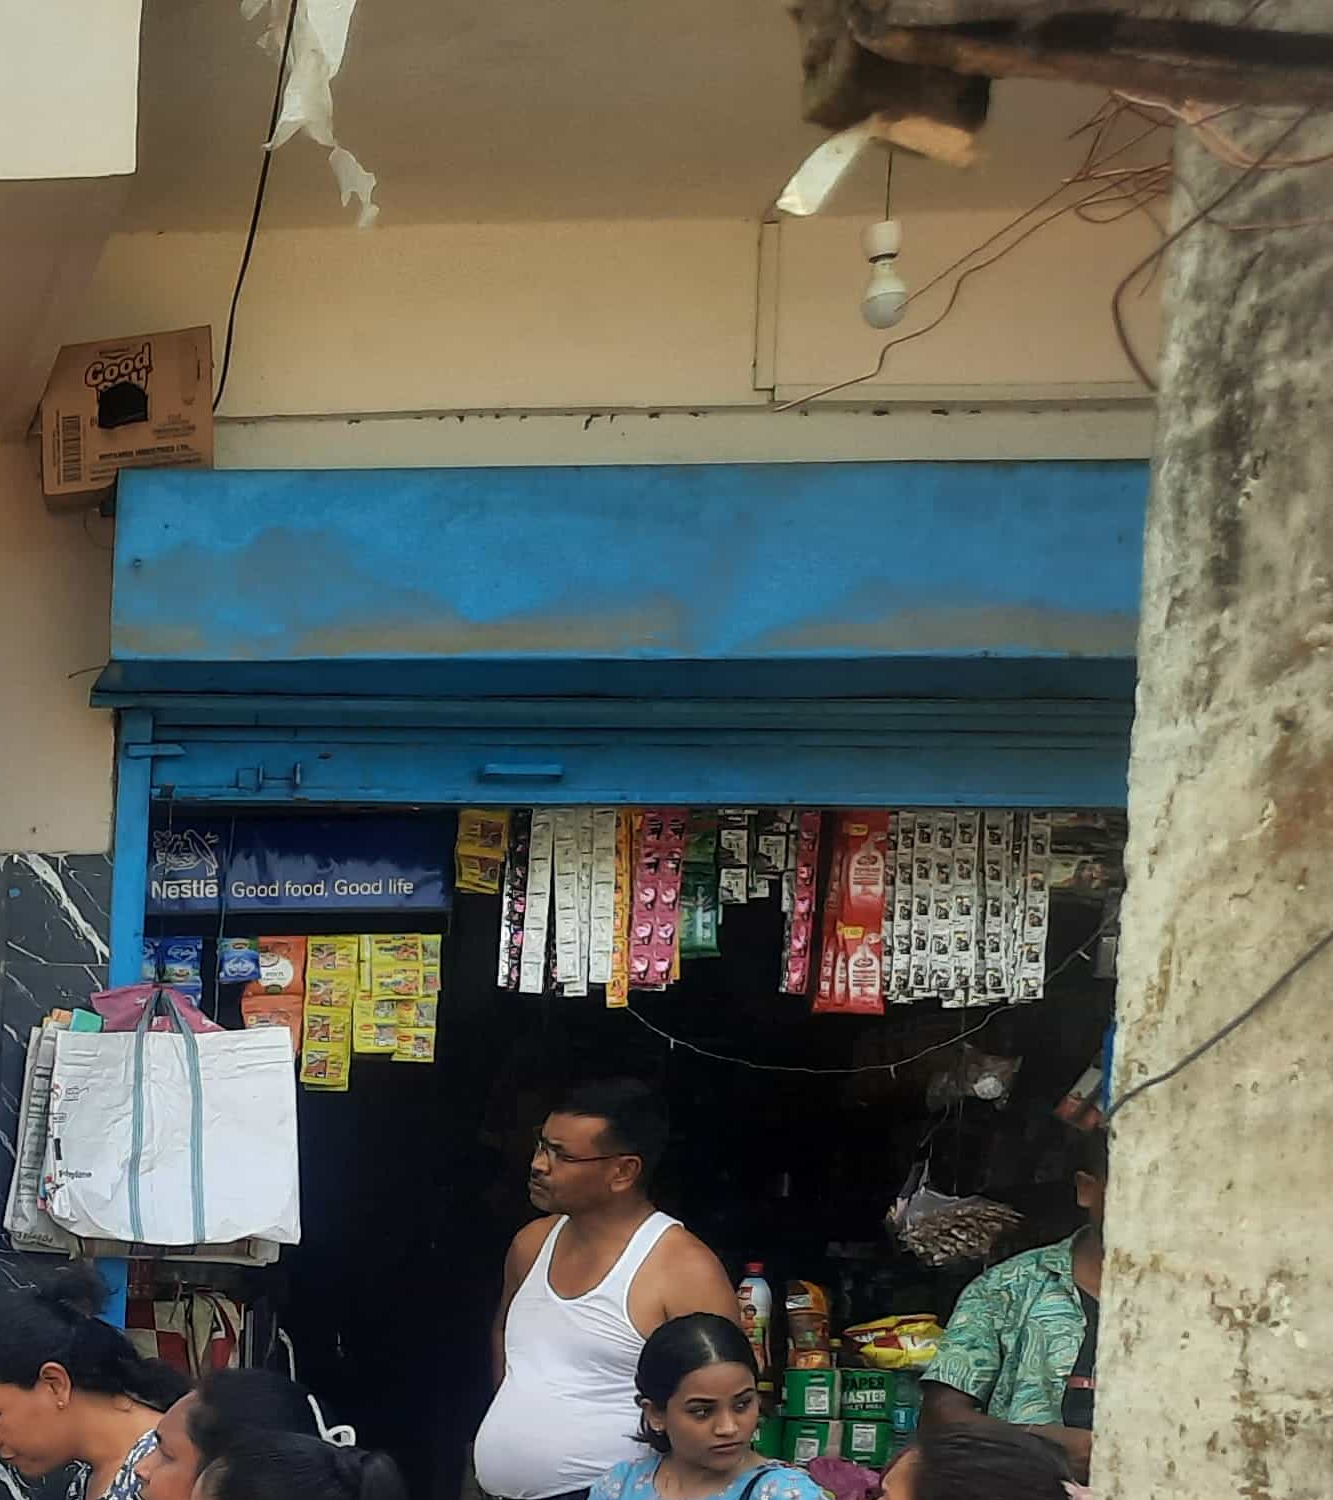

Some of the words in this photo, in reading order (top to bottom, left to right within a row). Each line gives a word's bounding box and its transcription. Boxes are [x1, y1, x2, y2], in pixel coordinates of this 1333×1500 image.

[85, 341, 152, 387] Good
[231, 880, 280, 899] Good
[284, 879, 329, 899] food,
[334, 878, 383, 896] Good
[388, 877, 415, 895] life
